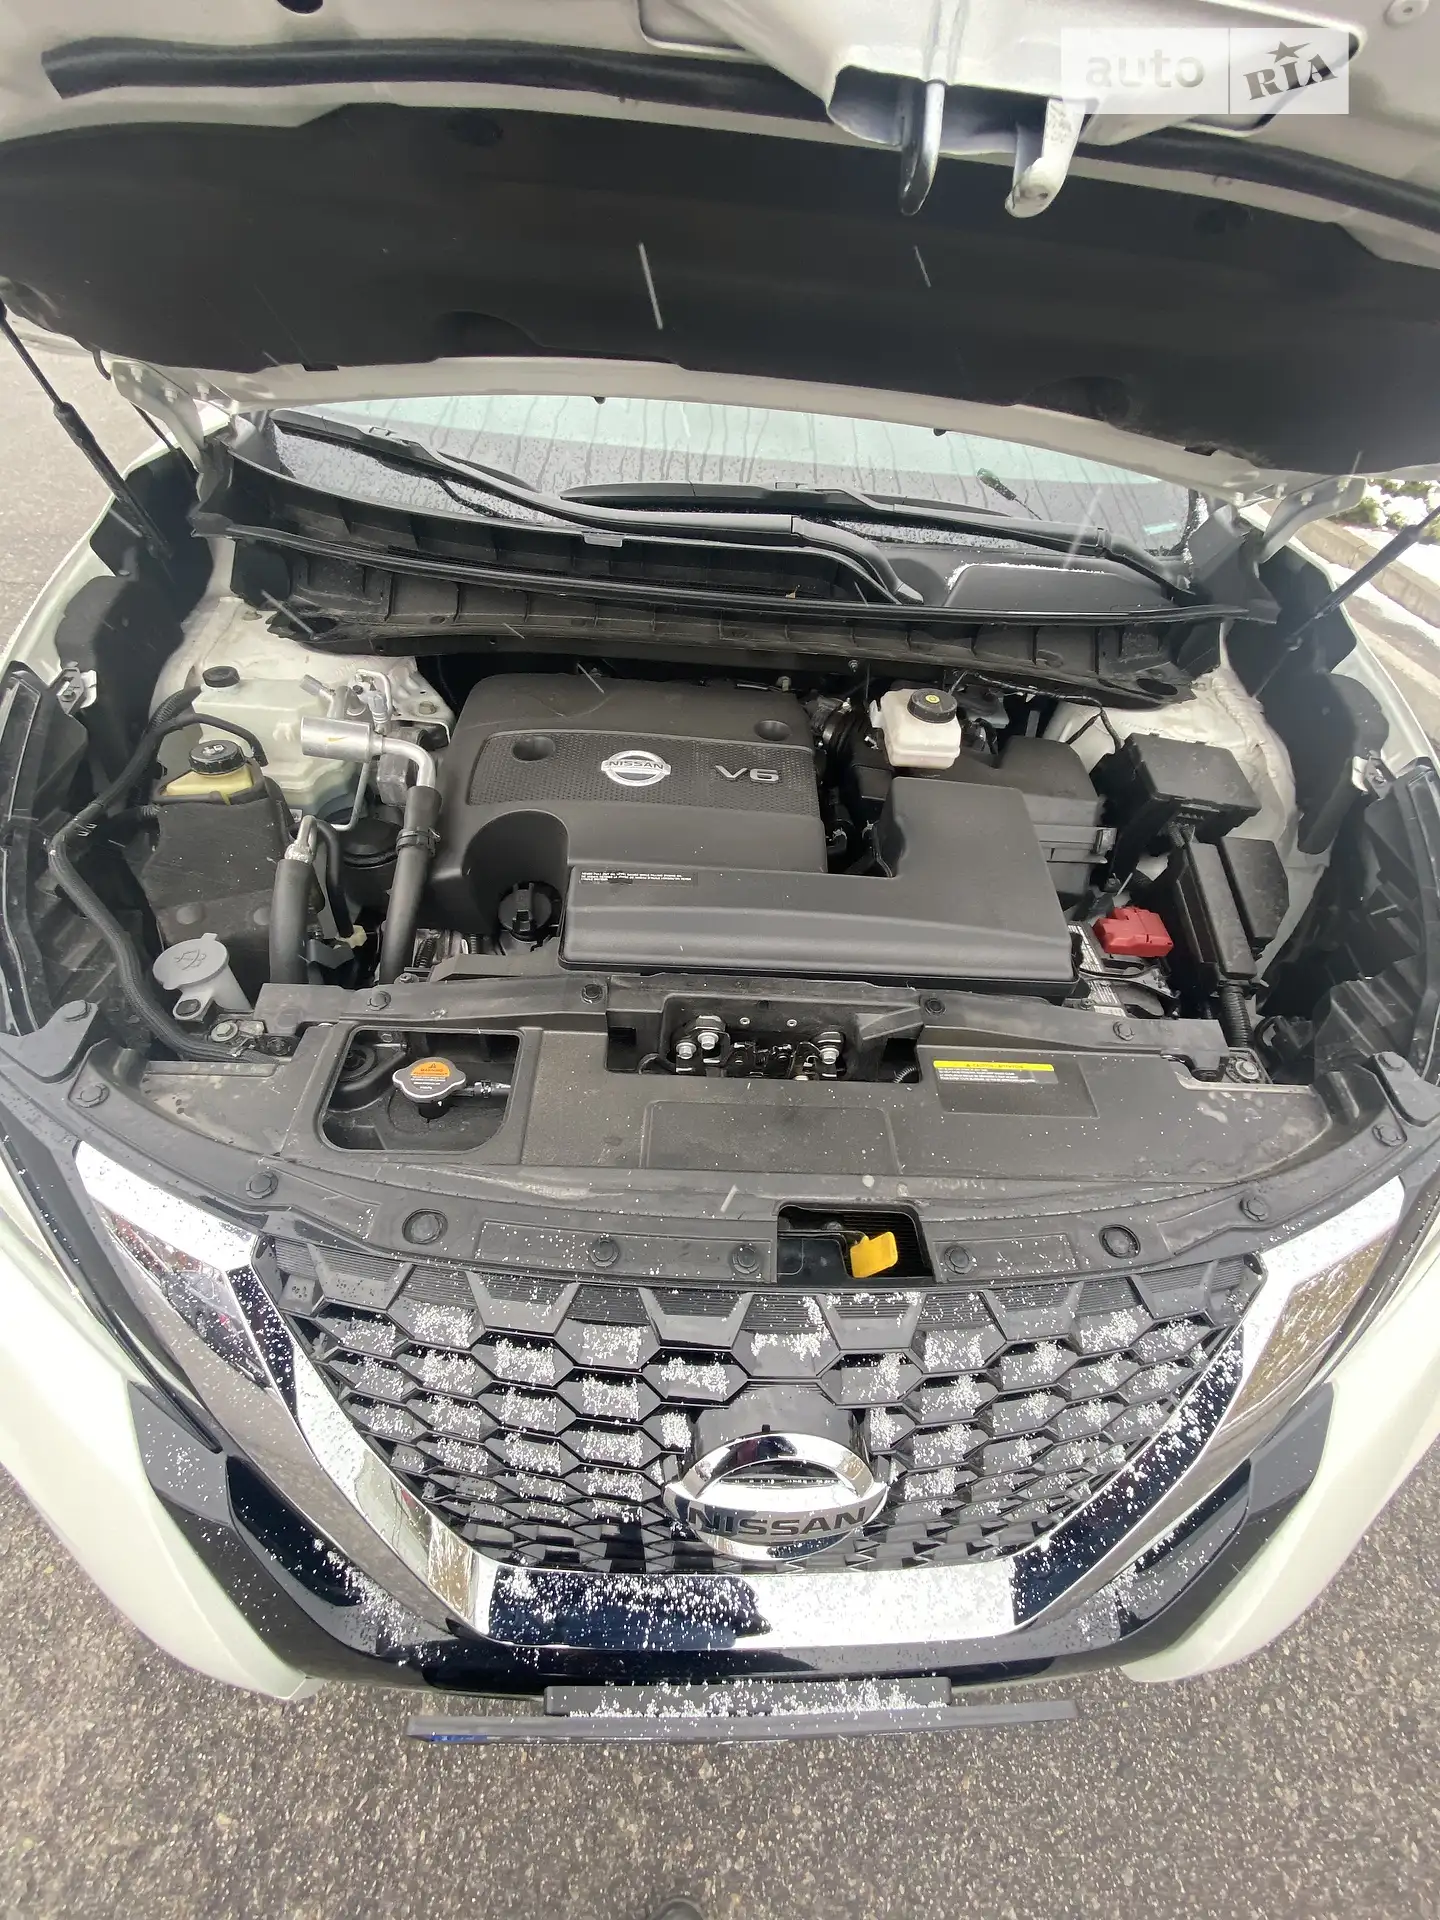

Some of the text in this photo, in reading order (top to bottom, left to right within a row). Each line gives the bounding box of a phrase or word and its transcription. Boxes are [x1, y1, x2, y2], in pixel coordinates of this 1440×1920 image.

[608, 760, 665, 770] NISSAN
[714, 765, 780, 783] V6
[687, 1506, 866, 1536] NISSAN
